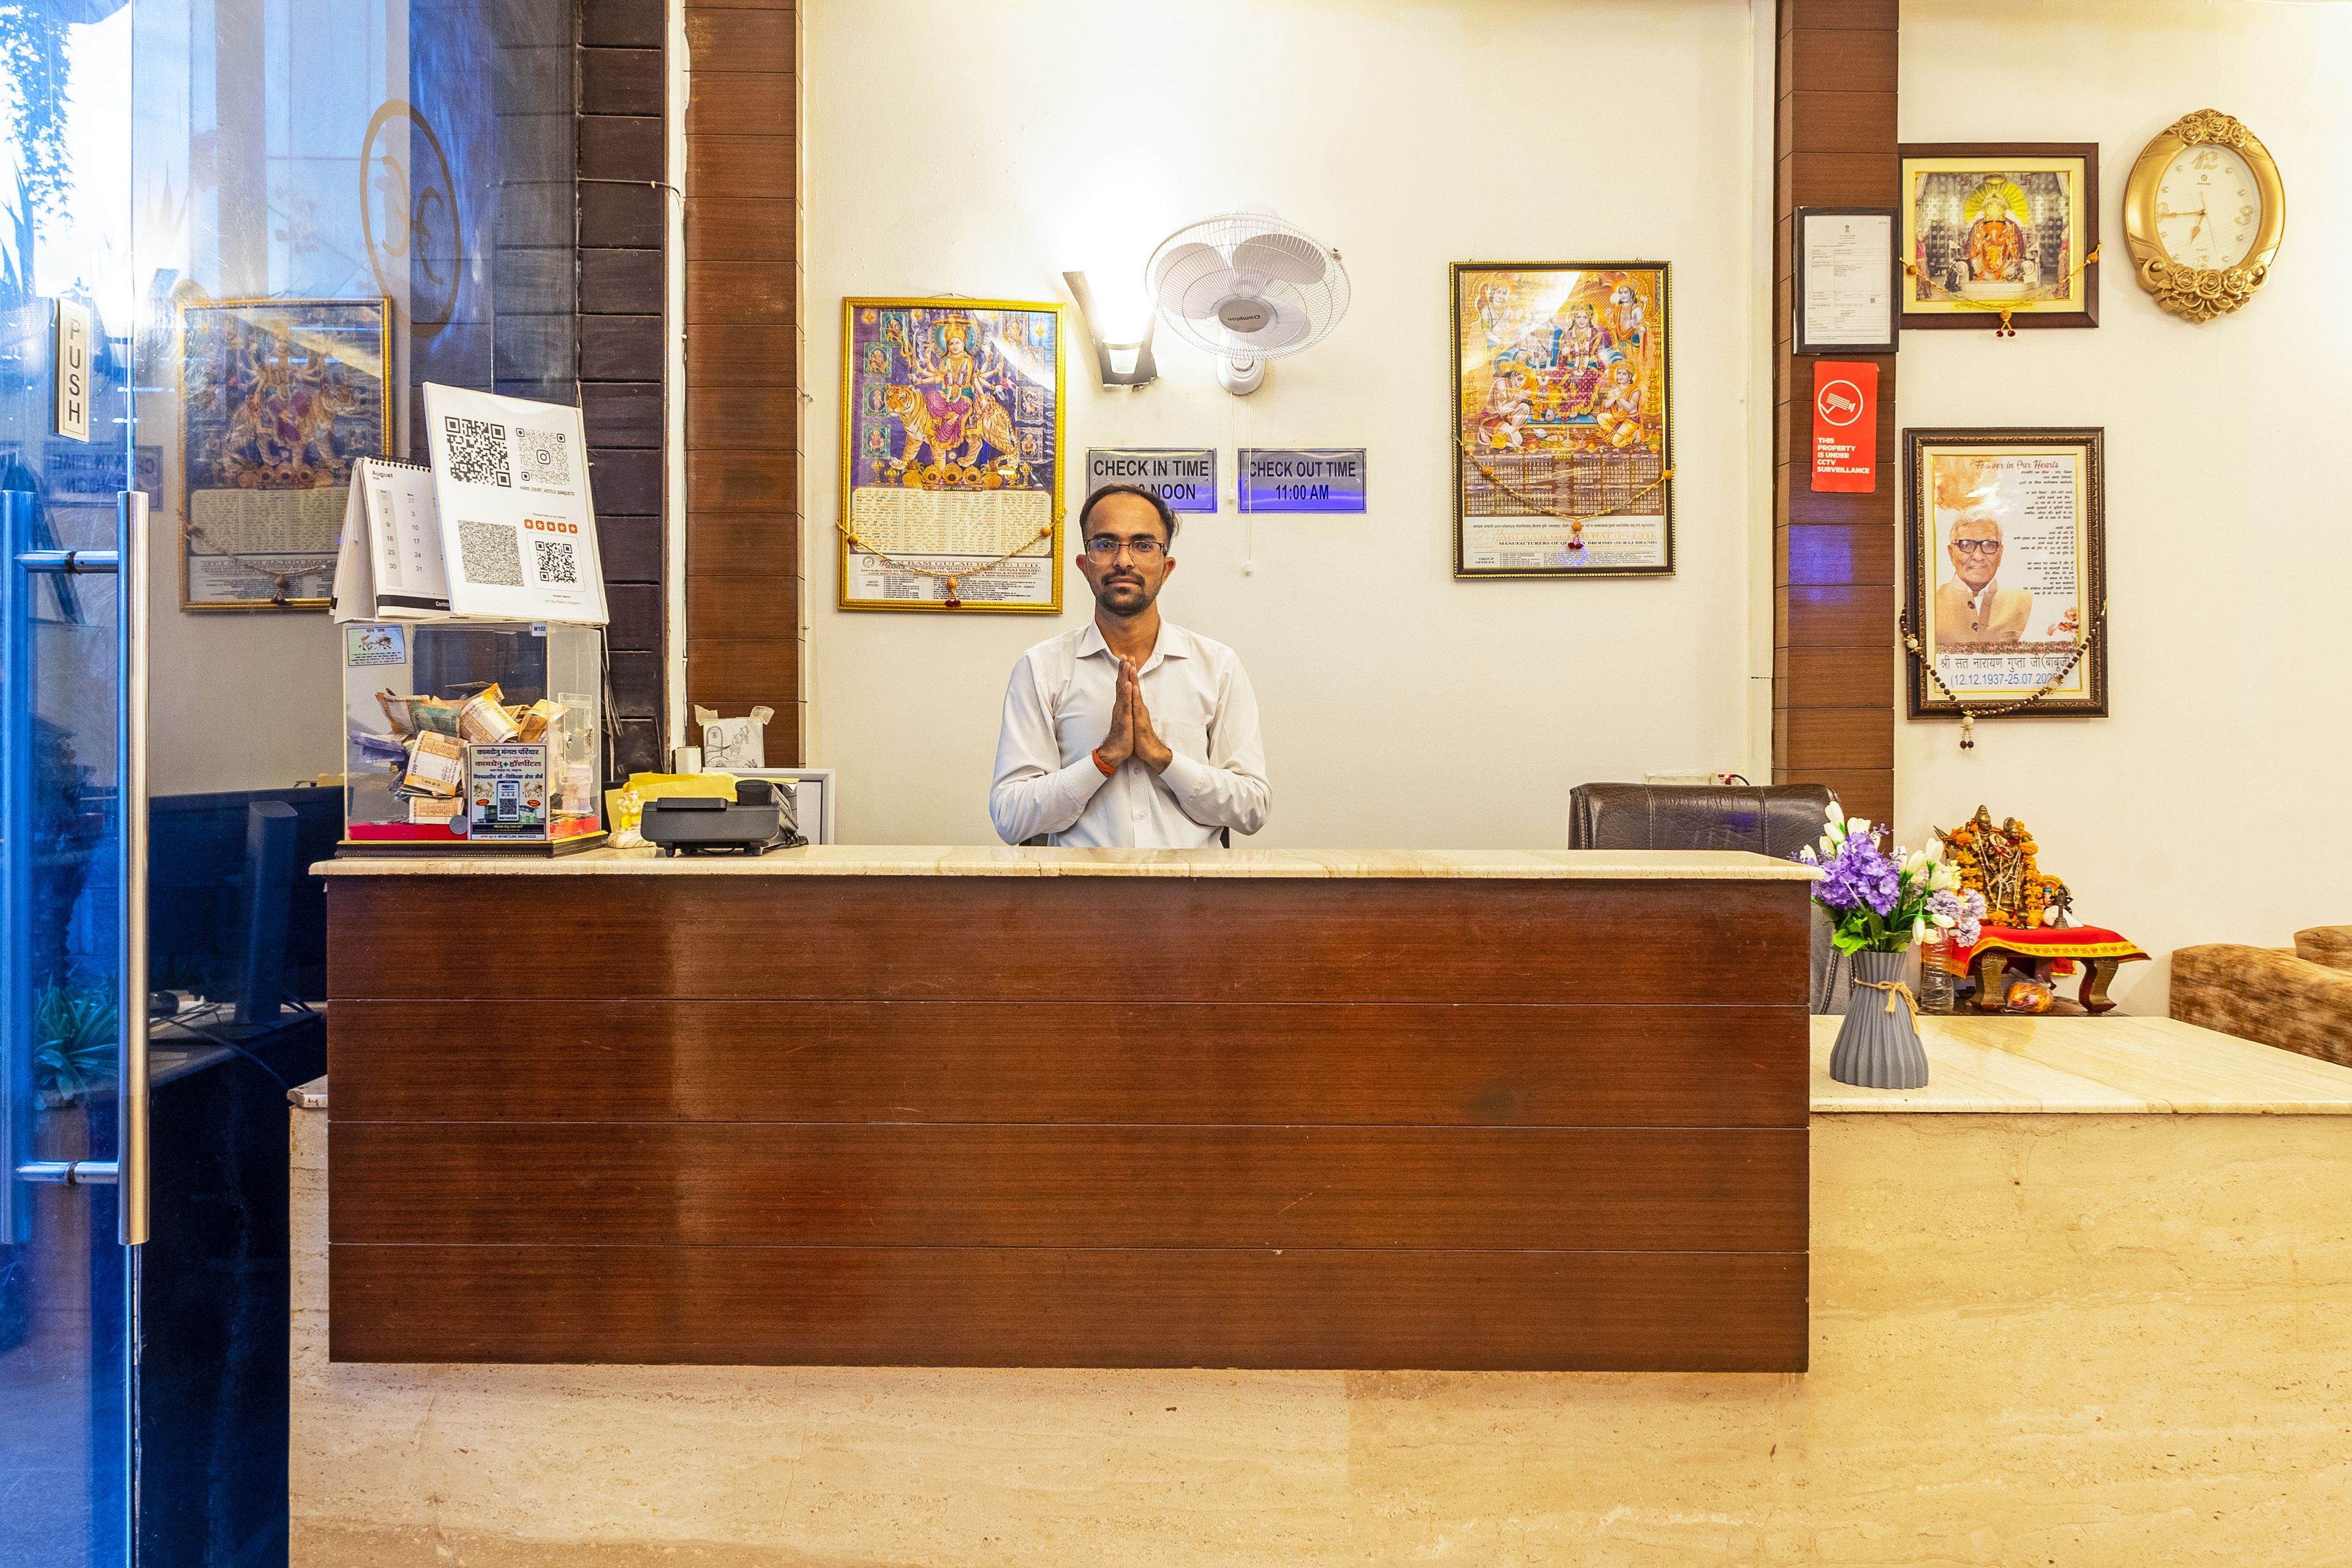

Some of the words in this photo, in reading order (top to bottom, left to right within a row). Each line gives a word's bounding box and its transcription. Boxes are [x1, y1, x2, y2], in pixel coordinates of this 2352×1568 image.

[2191, 150, 2219, 170] 12
[69, 318, 81, 424] PUSH
[1093, 459, 1147, 477] CHECK
[1153, 460, 1168, 476] IN
[1172, 461, 1209, 477] TIME
[1250, 461, 1292, 478] CHECK
[1296, 462, 1322, 477] OUT
[1325, 462, 1356, 478] TIME
[1975, 460, 2003, 469] Forever
[2016, 459, 2031, 470] Our
[2034, 460, 2059, 469] Hearts
[1150, 483, 1196, 500] NOON
[1275, 484, 1306, 500] 11:00
[1310, 484, 1329, 500] AM
[1940, 655, 1950, 669] श्री
[1954, 658, 1969, 669] सत
[1973, 658, 2003, 669] नारायण
[2007, 657, 2026, 673] गुप्ता
[477, 748, 501, 756] कामधेनु
[475, 760, 503, 768] कामधेनु
